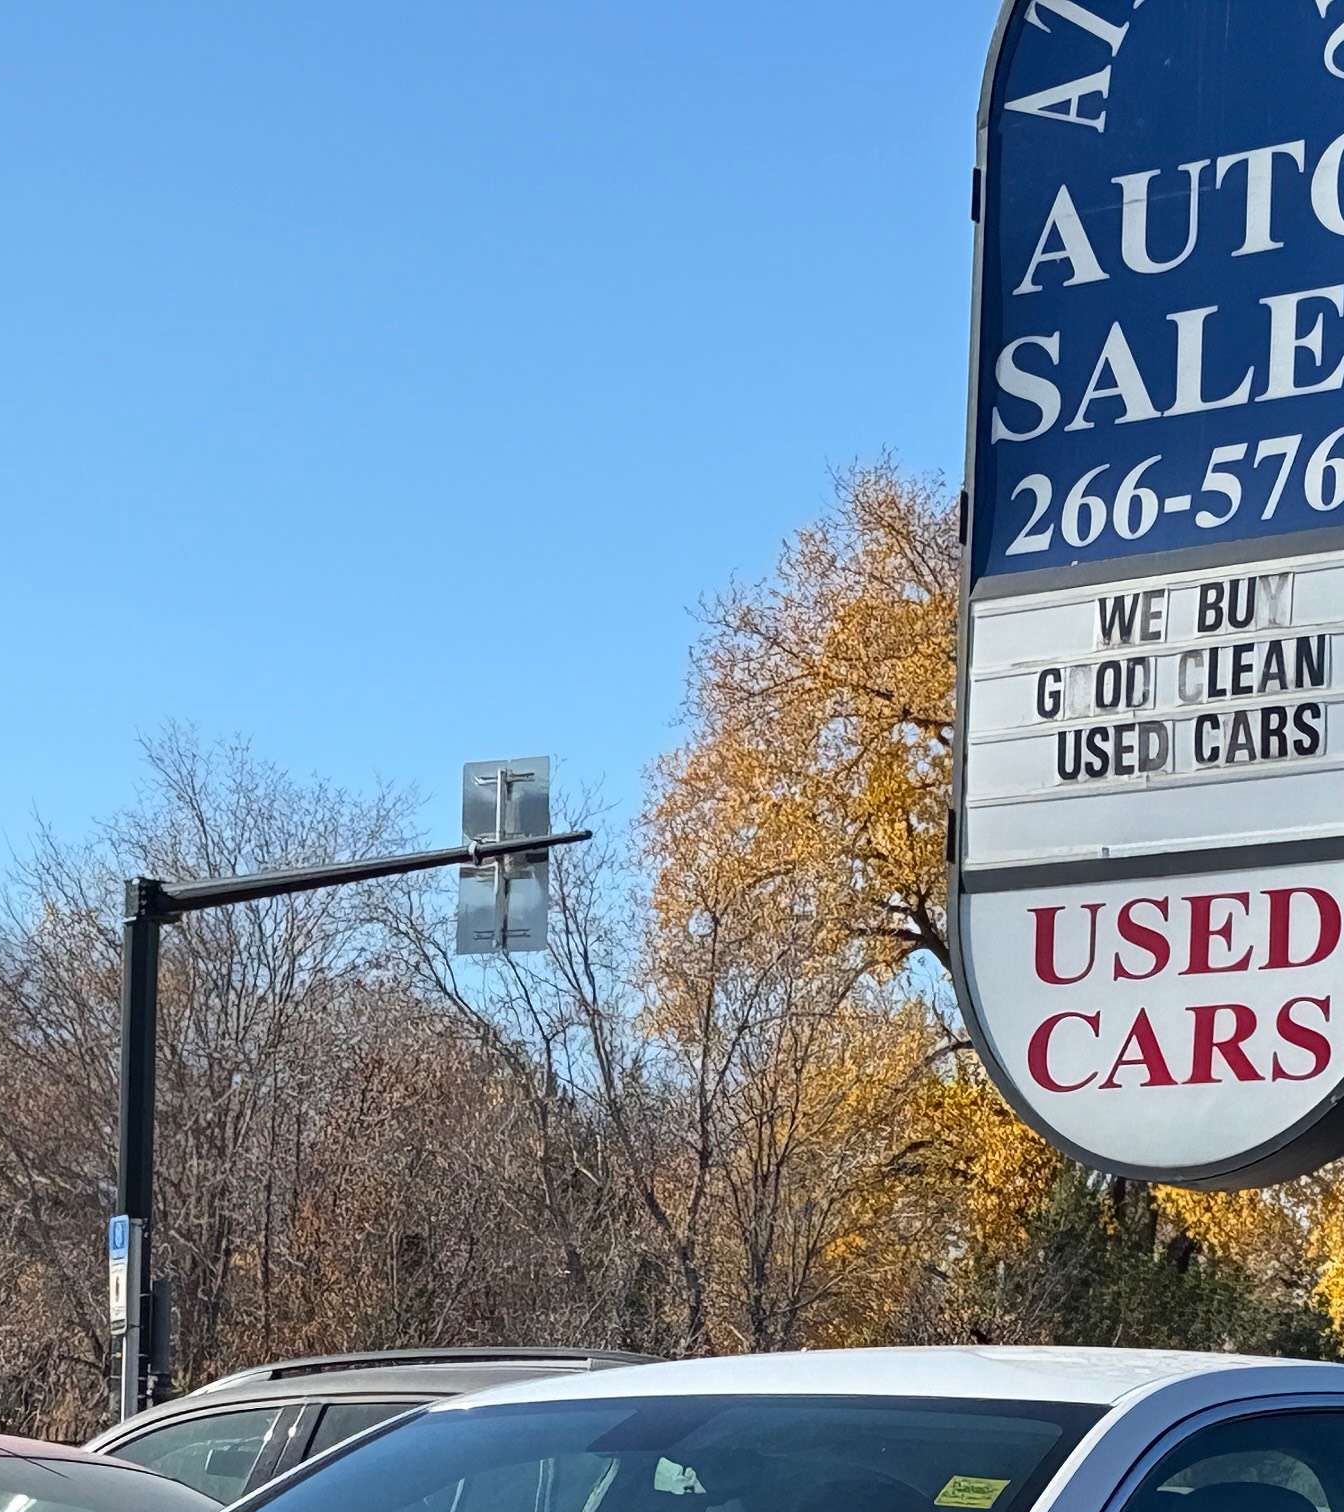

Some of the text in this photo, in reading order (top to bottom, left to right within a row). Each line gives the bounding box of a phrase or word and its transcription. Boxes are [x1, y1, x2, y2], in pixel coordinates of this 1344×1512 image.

[1097, 573, 1290, 642] WE BUY
[1036, 634, 1326, 720] GOD CLEAN
[1057, 702, 1322, 781] USED CARS
[1027, 887, 1343, 985] USED
[1027, 995, 1332, 1093] CARS
